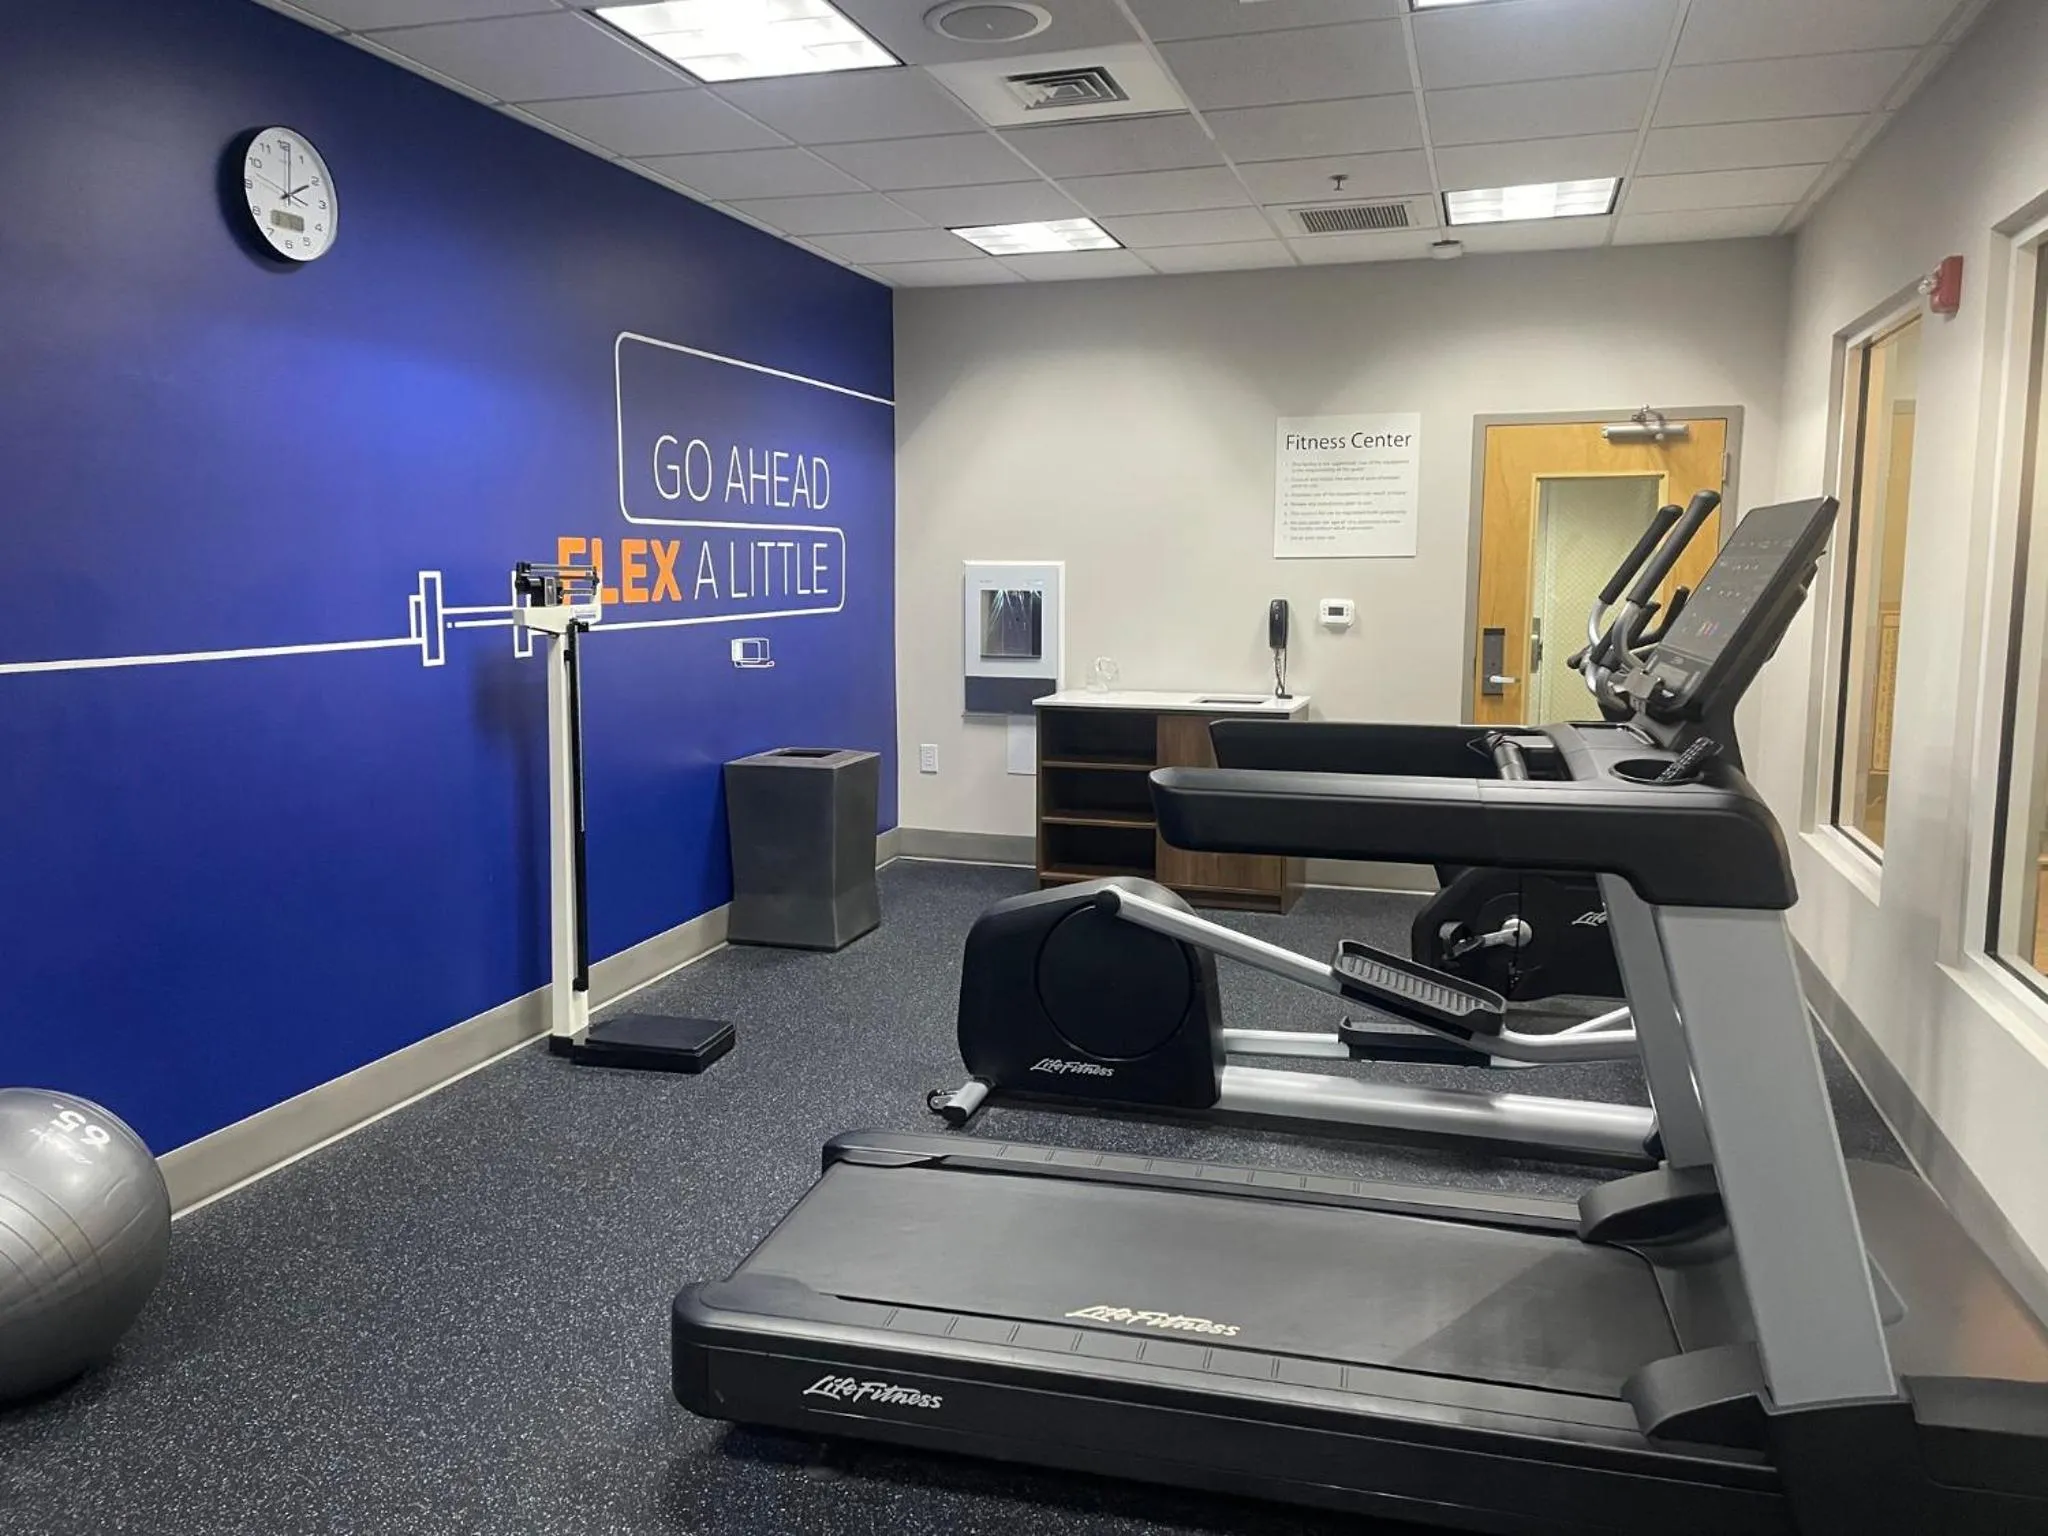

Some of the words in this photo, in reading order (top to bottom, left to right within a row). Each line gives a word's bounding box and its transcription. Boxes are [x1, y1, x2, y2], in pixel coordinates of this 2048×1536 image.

[260, 143, 271, 154] 11
[249, 157, 262, 169] 10
[311, 176, 320, 186] 2
[319, 200, 327, 210] 3
[266, 227, 275, 237] 7
[315, 224, 323, 232] 4
[285, 239, 294, 249] 6
[303, 236, 311, 246] 5
[1286, 433, 1346, 451] Fitness
[1351, 432, 1412, 449] Center
[653, 434, 713, 502] GO
[725, 445, 831, 511] AHEAD
[557, 536, 682, 606] FLEX
[694, 540, 719, 600] A
[731, 541, 829, 599] LITTLE
